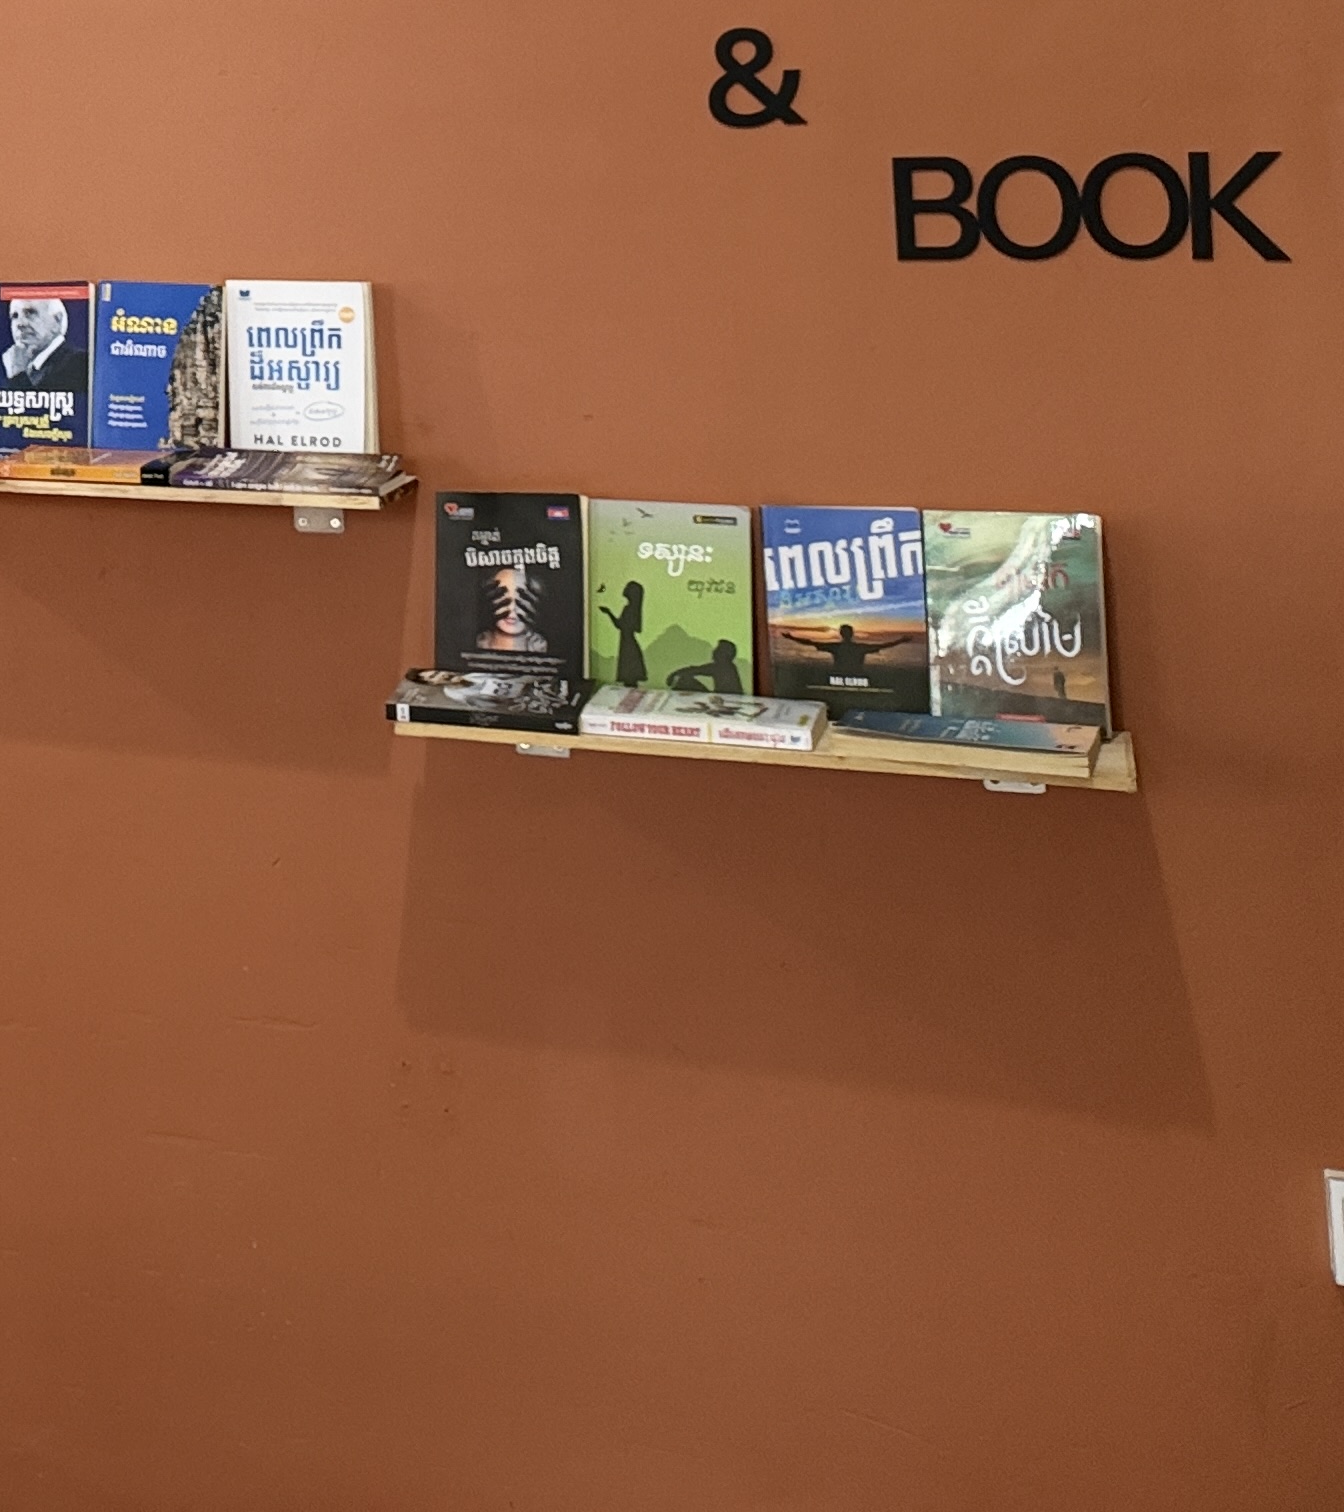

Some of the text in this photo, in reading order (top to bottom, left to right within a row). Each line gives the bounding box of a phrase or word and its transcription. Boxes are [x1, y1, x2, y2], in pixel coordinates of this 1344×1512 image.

[708, 27, 808, 130] &
[891, 151, 1292, 263] BOOK
[246, 319, 343, 357] ពេលព្រឹក
[249, 350, 340, 391] ដ៏អស្ចារ្យ
[254, 434, 341, 448] HAL ELROD
